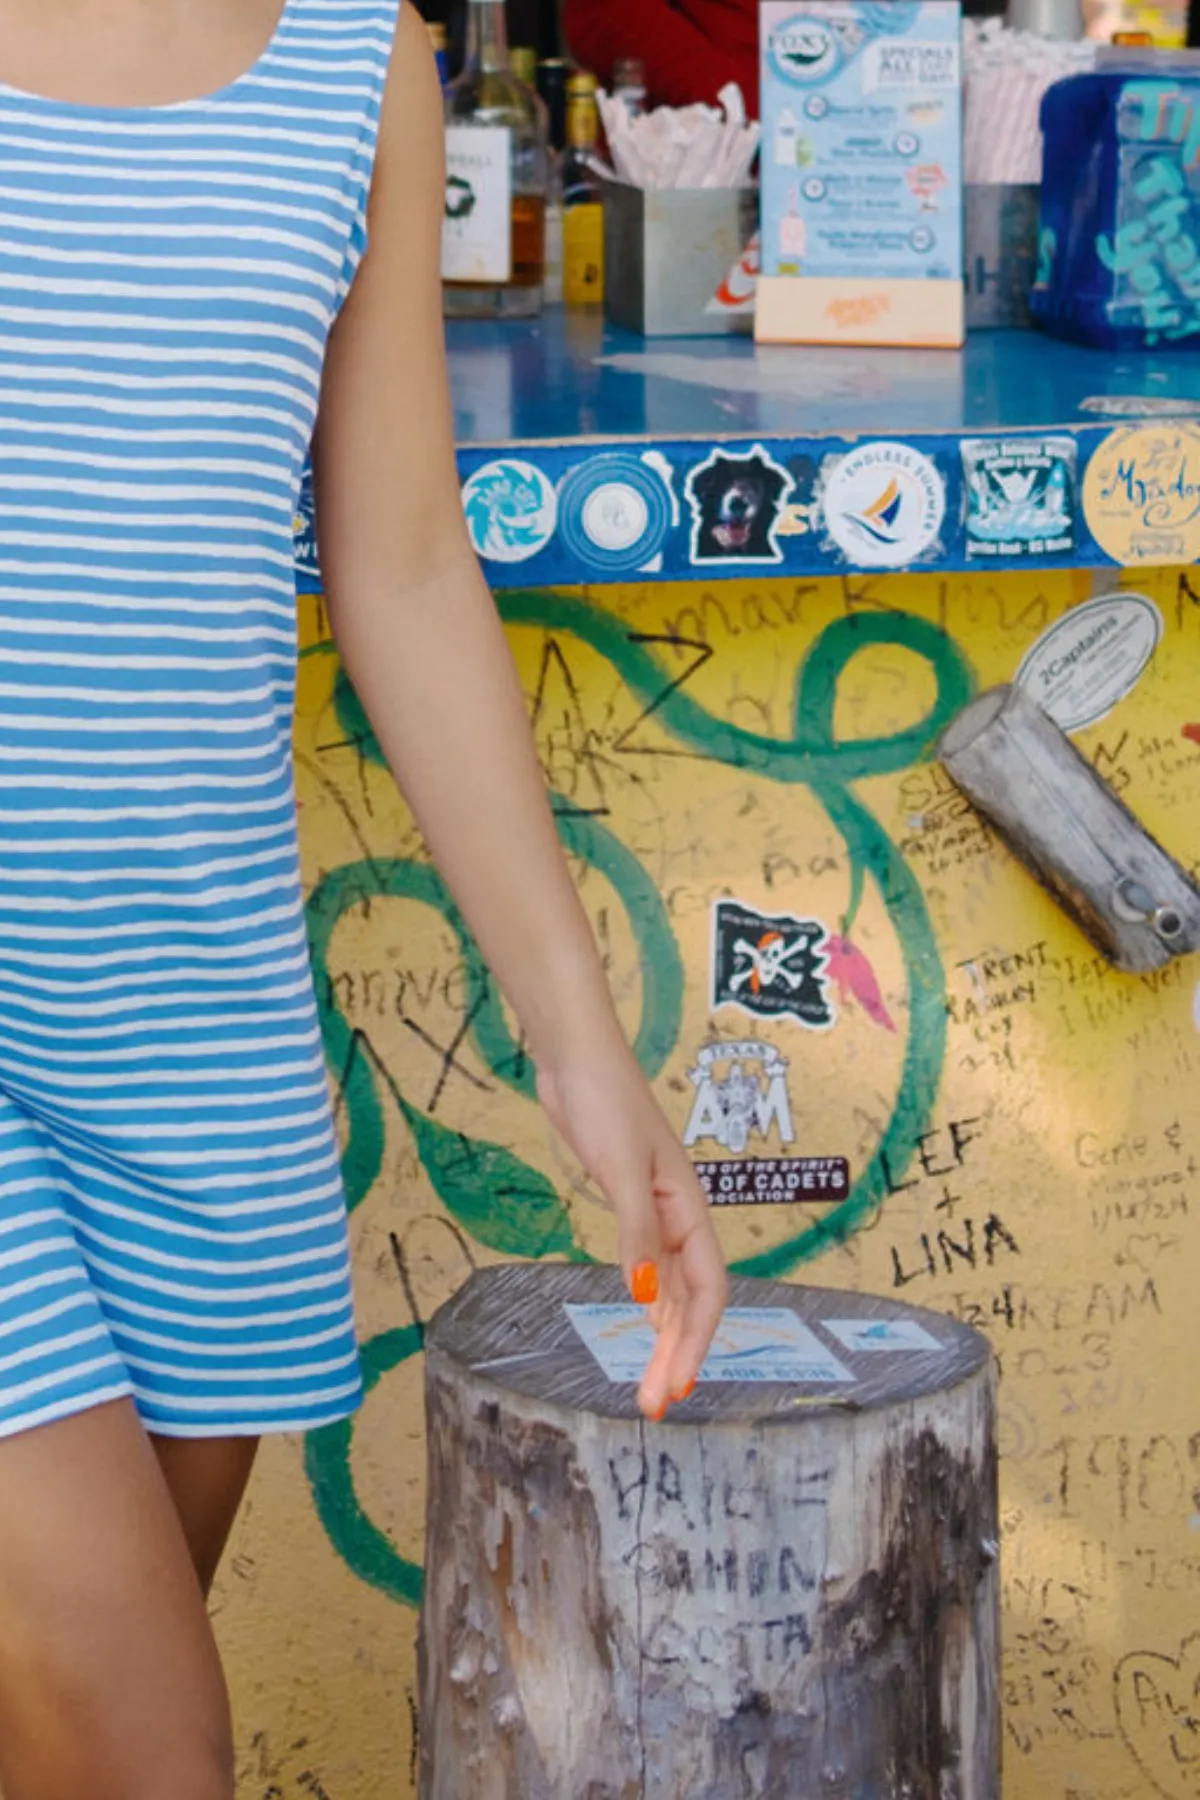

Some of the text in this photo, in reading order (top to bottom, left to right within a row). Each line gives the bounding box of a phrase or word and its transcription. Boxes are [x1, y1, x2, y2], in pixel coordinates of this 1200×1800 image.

[710, 1041, 767, 1060] TEXAS
[719, 1175, 748, 1191] OF
[754, 1171, 846, 1190] CADETS
[891, 1212, 1023, 1288] LINA
